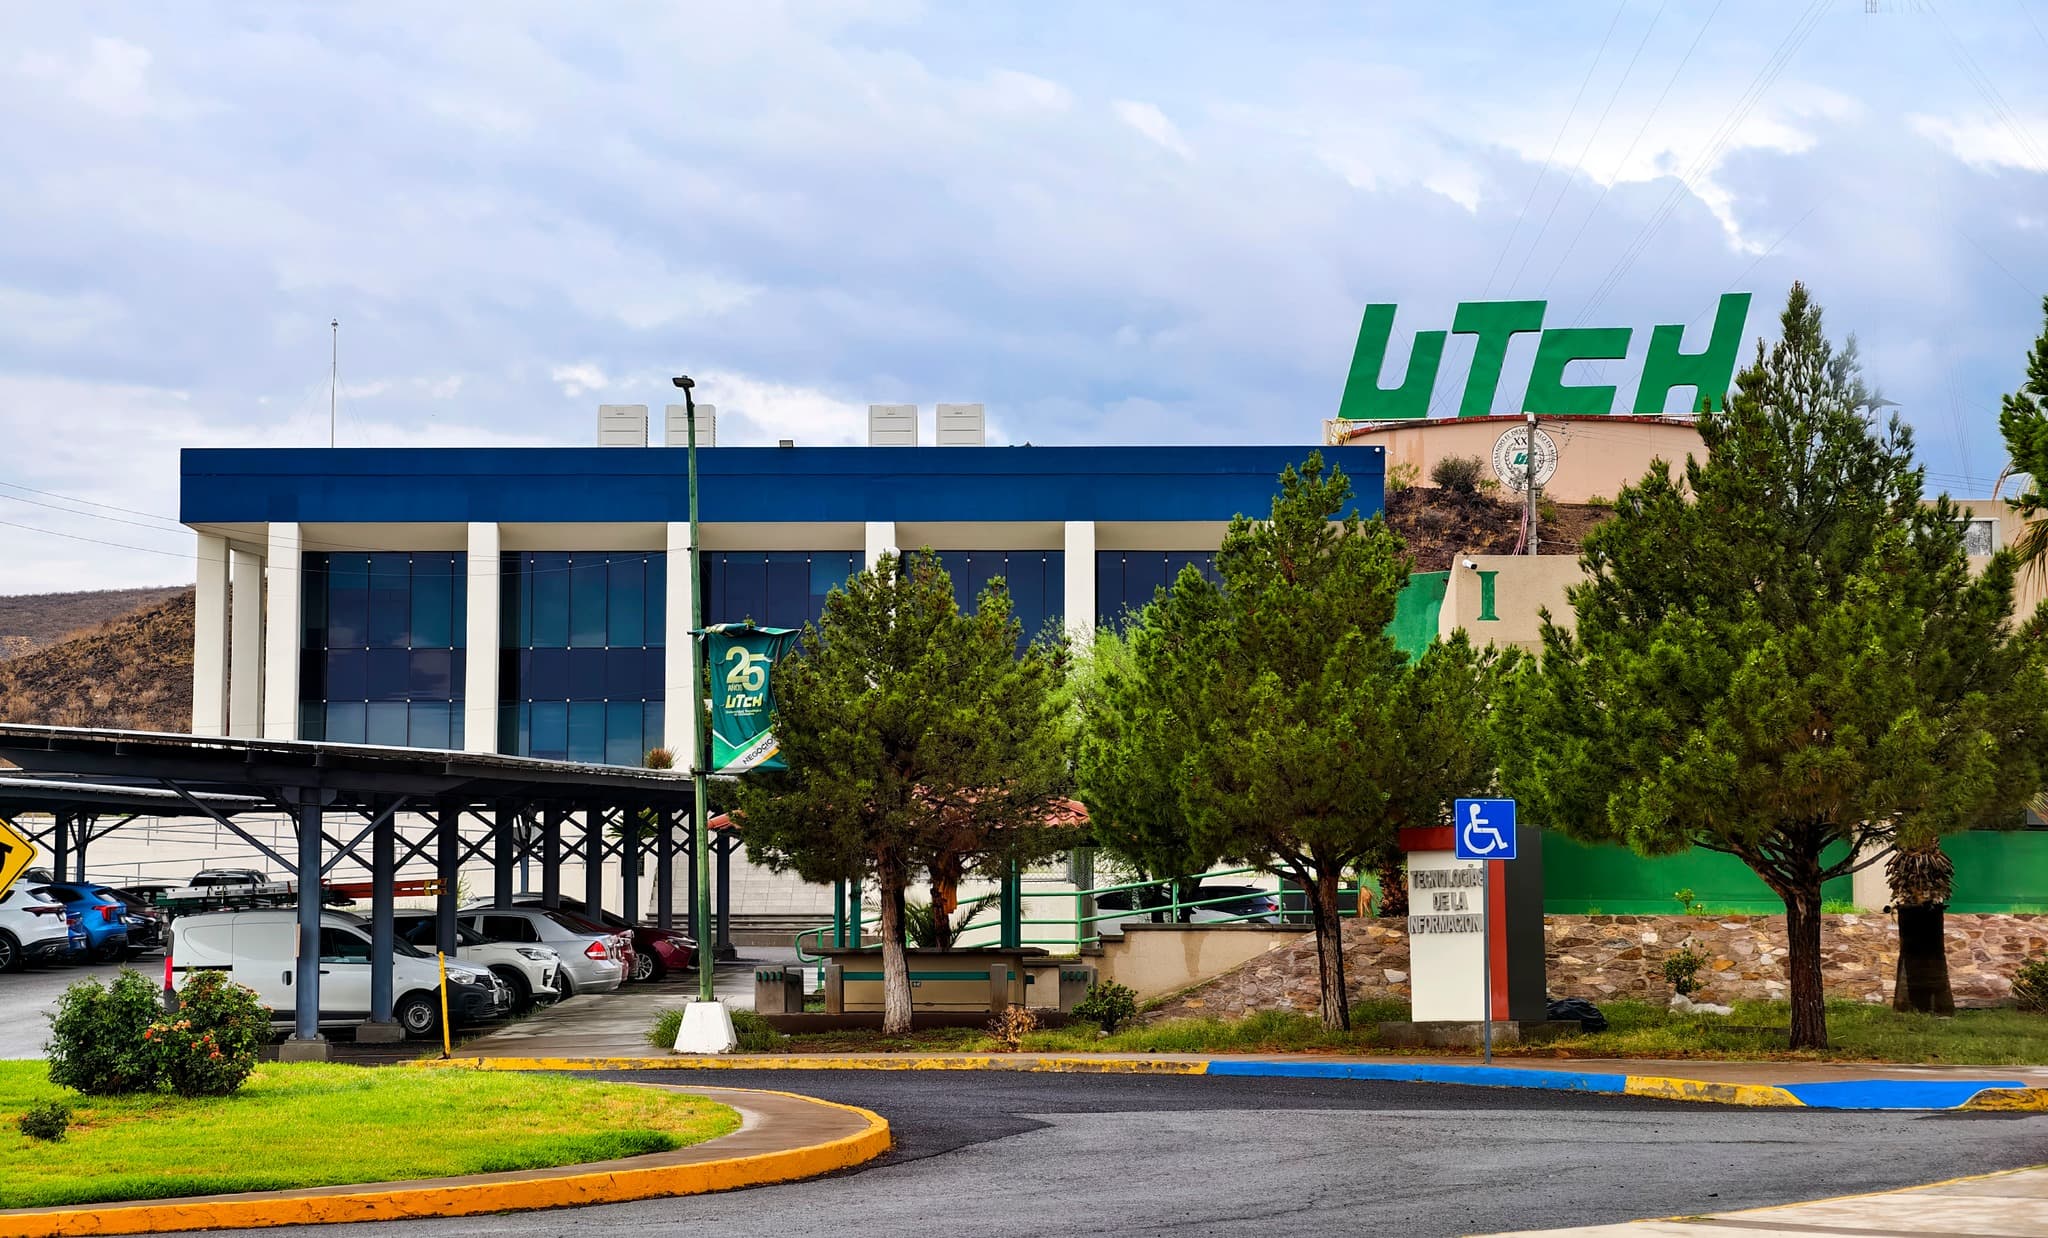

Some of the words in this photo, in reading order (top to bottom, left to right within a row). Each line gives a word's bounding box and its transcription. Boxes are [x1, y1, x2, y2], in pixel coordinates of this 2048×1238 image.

[1338, 292, 1752, 420] UTCH
[726, 646, 766, 691] 25
[725, 693, 763, 708] UTCH
[742, 736, 775, 765] NEGOCIO
[1433, 892, 1450, 911] DE
[1451, 892, 1468, 911] LA
